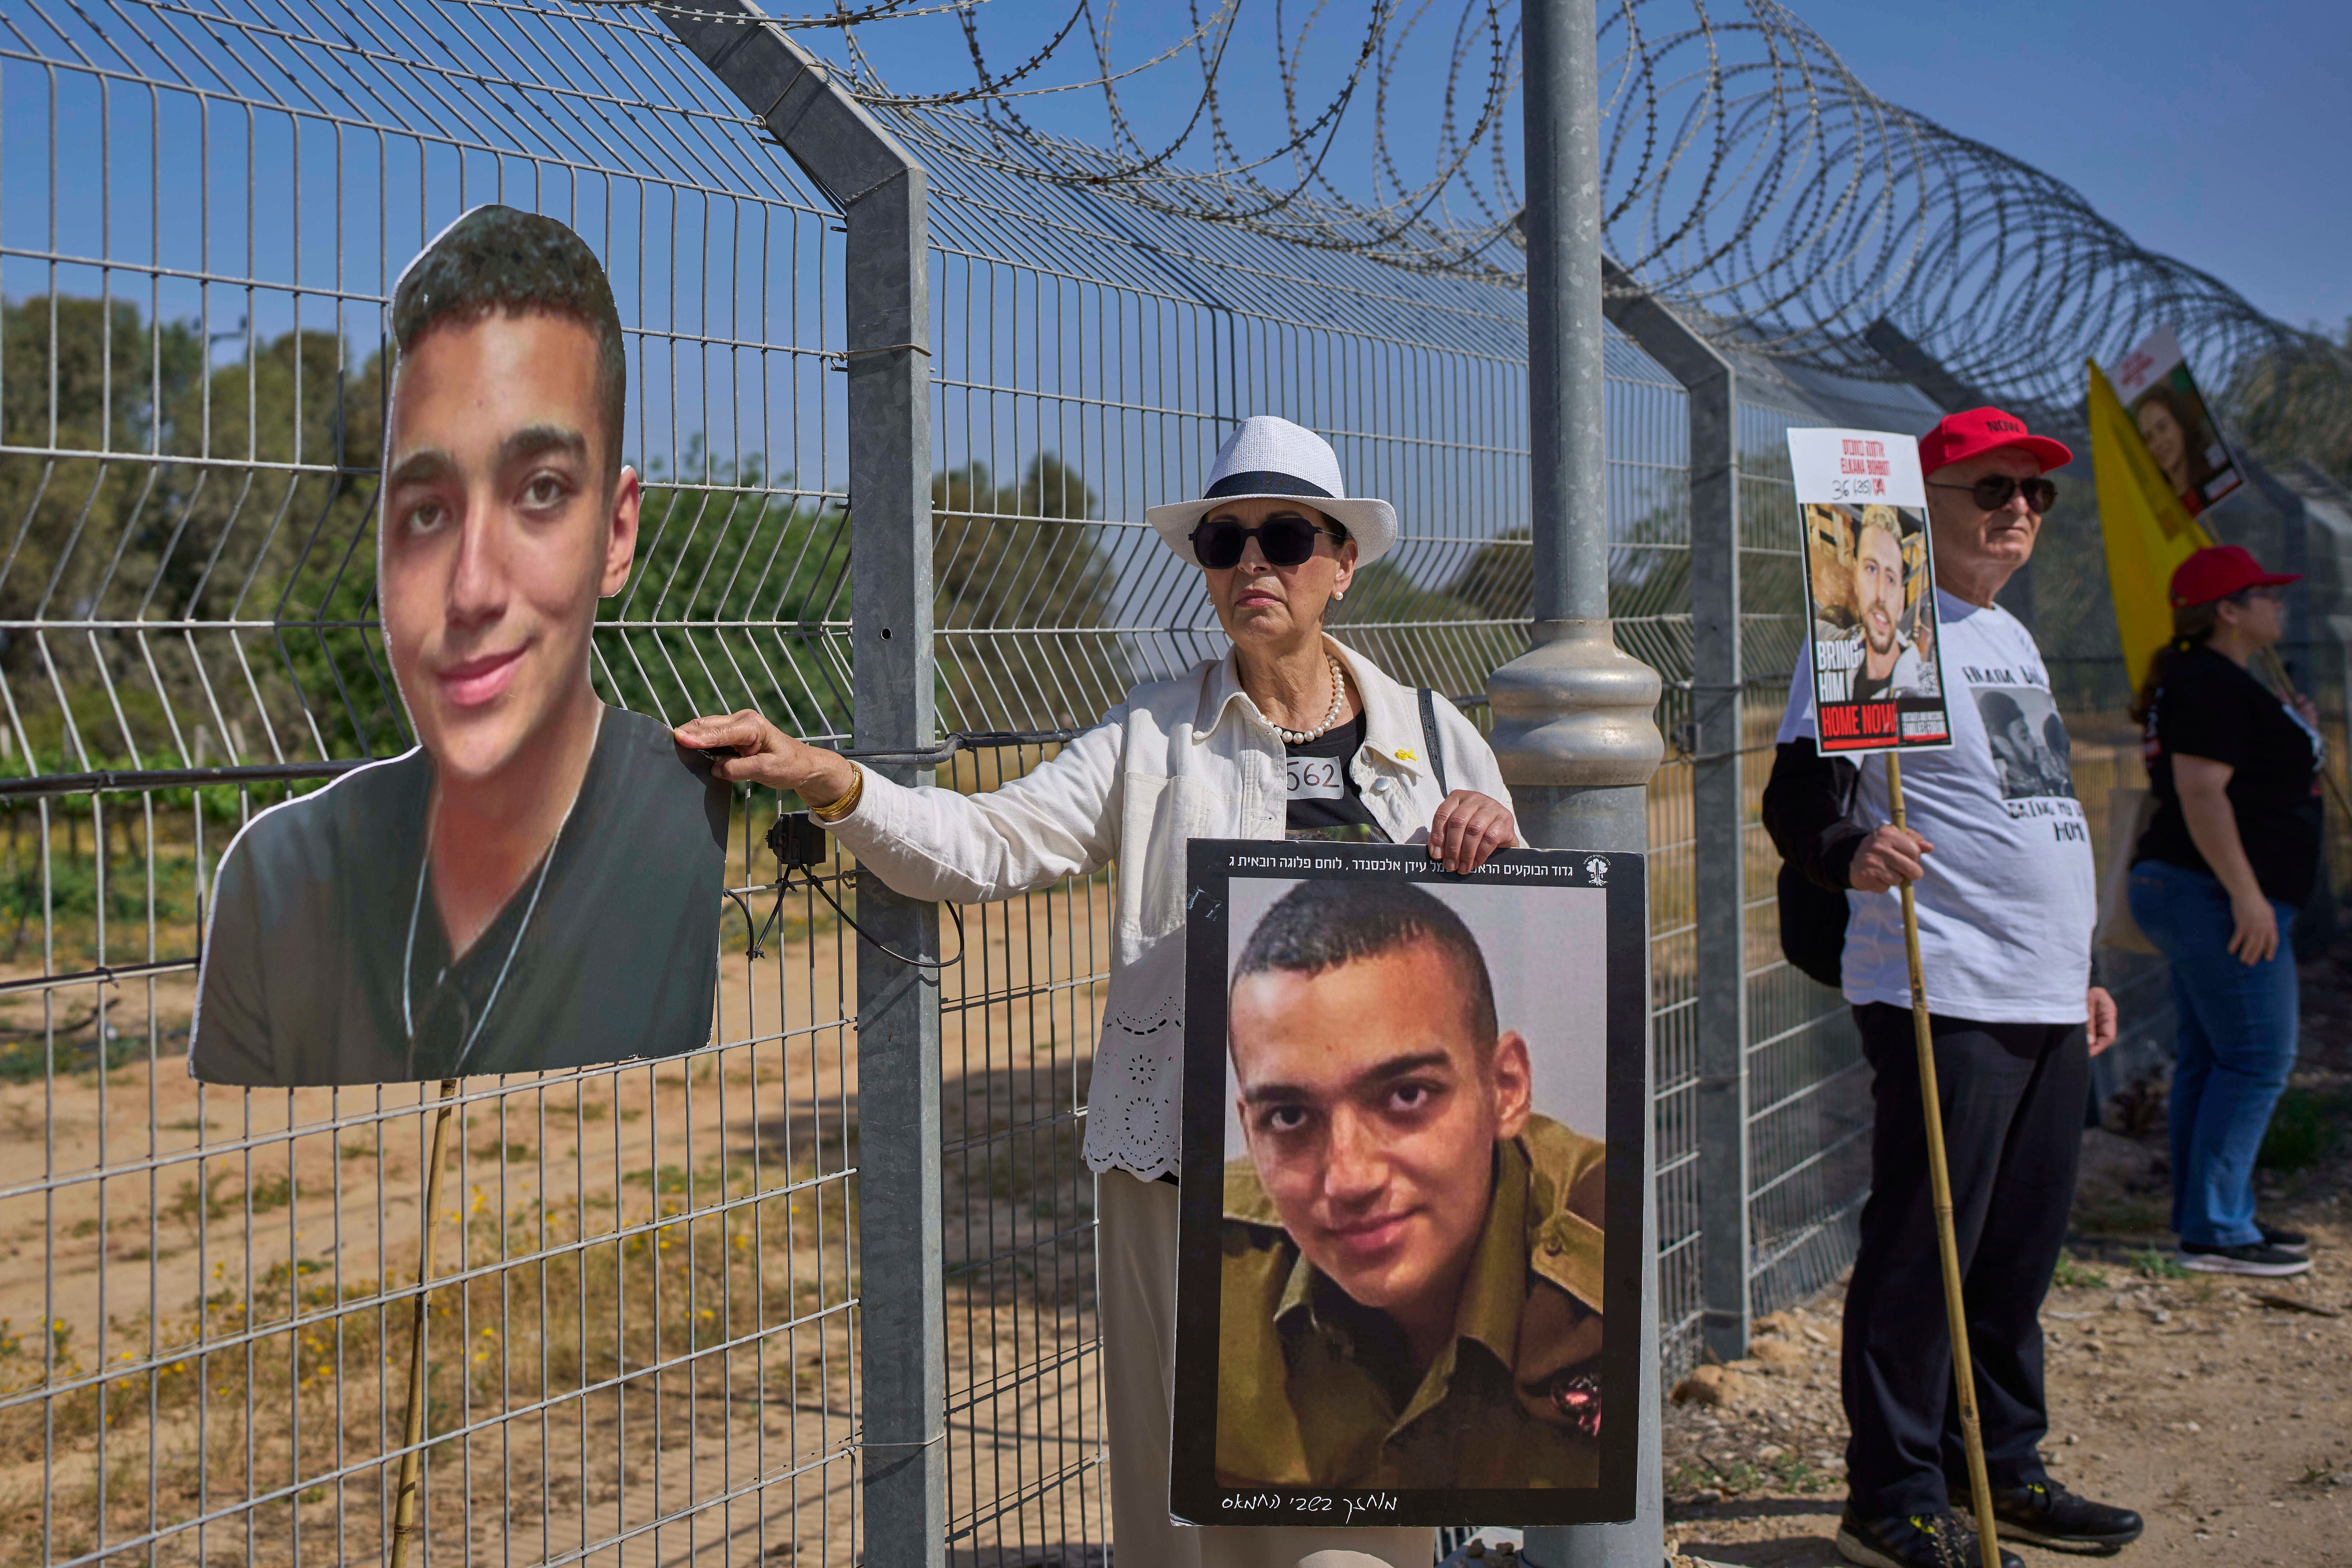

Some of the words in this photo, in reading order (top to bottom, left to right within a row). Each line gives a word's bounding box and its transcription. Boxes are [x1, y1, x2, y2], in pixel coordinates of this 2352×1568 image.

[1832, 479, 1849, 500] 36
[1816, 639, 1861, 671] BRING
[1818, 671, 1846, 702] HIM
[1821, 706, 1860, 737] HOME
[1287, 761, 1340, 791] 562
[1229, 856, 1234, 866] ג
[1237, 856, 1276, 867] רובאית
[1280, 856, 1311, 868] פלוגה
[1315, 857, 1342, 869] לוחם
[1352, 858, 1401, 871] אלכסנדר
[1405, 861, 1426, 874] עידן
[1504, 865, 1548, 877] הבוקעים
[1551, 866, 1573, 876] גדוד
[1222, 1494, 1280, 1509] החמאס
[1290, 1496, 1332, 1511] בשבי
